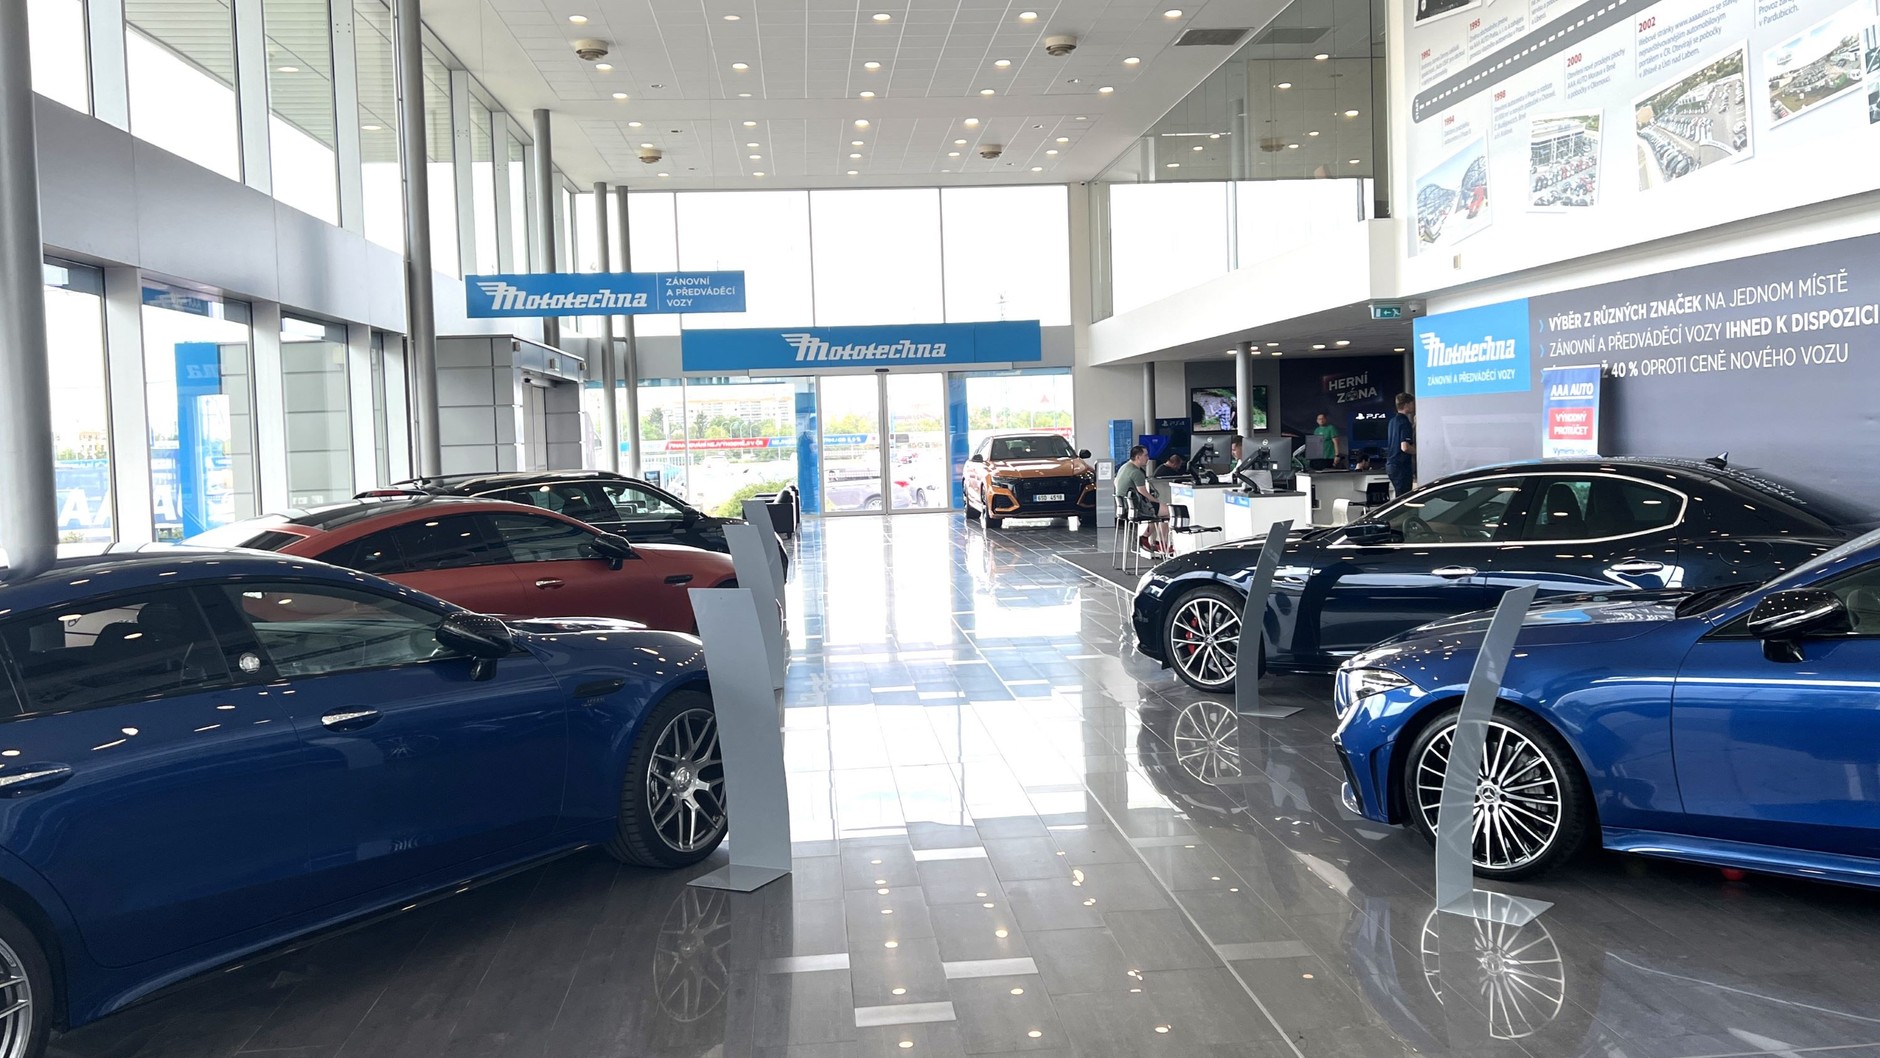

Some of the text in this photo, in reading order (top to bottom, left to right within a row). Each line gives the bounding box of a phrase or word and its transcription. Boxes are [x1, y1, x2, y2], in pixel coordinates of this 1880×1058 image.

[1638, 16, 1656, 33] 2002
[1567, 52, 1583, 68] 2000
[666, 276, 710, 286] ZÁNOVNÍ
[476, 281, 648, 310] Mototechna
[666, 285, 736, 297] A PŘEDVÁDĚCÍ
[1549, 268, 1849, 332] VÝBĚR Z RŮZNÝCH ZNAČEK NA JEDNOM MÍSTĚ
[667, 298, 693, 307] VOZY
[1549, 304, 1879, 357] ZÁNOVNÍ A PŘEDVÁDĚCÍ VOZY IHNED K DISPOZICI
[781, 333, 947, 361] Mototechna
[1419, 332, 1516, 368] Mototechna
[1611, 361, 1627, 378] 40
[1628, 360, 1639, 377] %
[1641, 356, 1687, 376] OPROTI
[1690, 349, 1727, 373] CENĚ
[1730, 345, 1797, 370] NOVÉHO
[1800, 343, 1849, 365] VOZU
[1328, 371, 1368, 391] HERNÍ
[1427, 372, 1453, 386] ZÁNOVNÍ
[1459, 369, 1497, 383] PŘEDVÁDĚCÍ
[1497, 368, 1516, 380] VOZY
[1550, 382, 1594, 397] AAA AUTO
